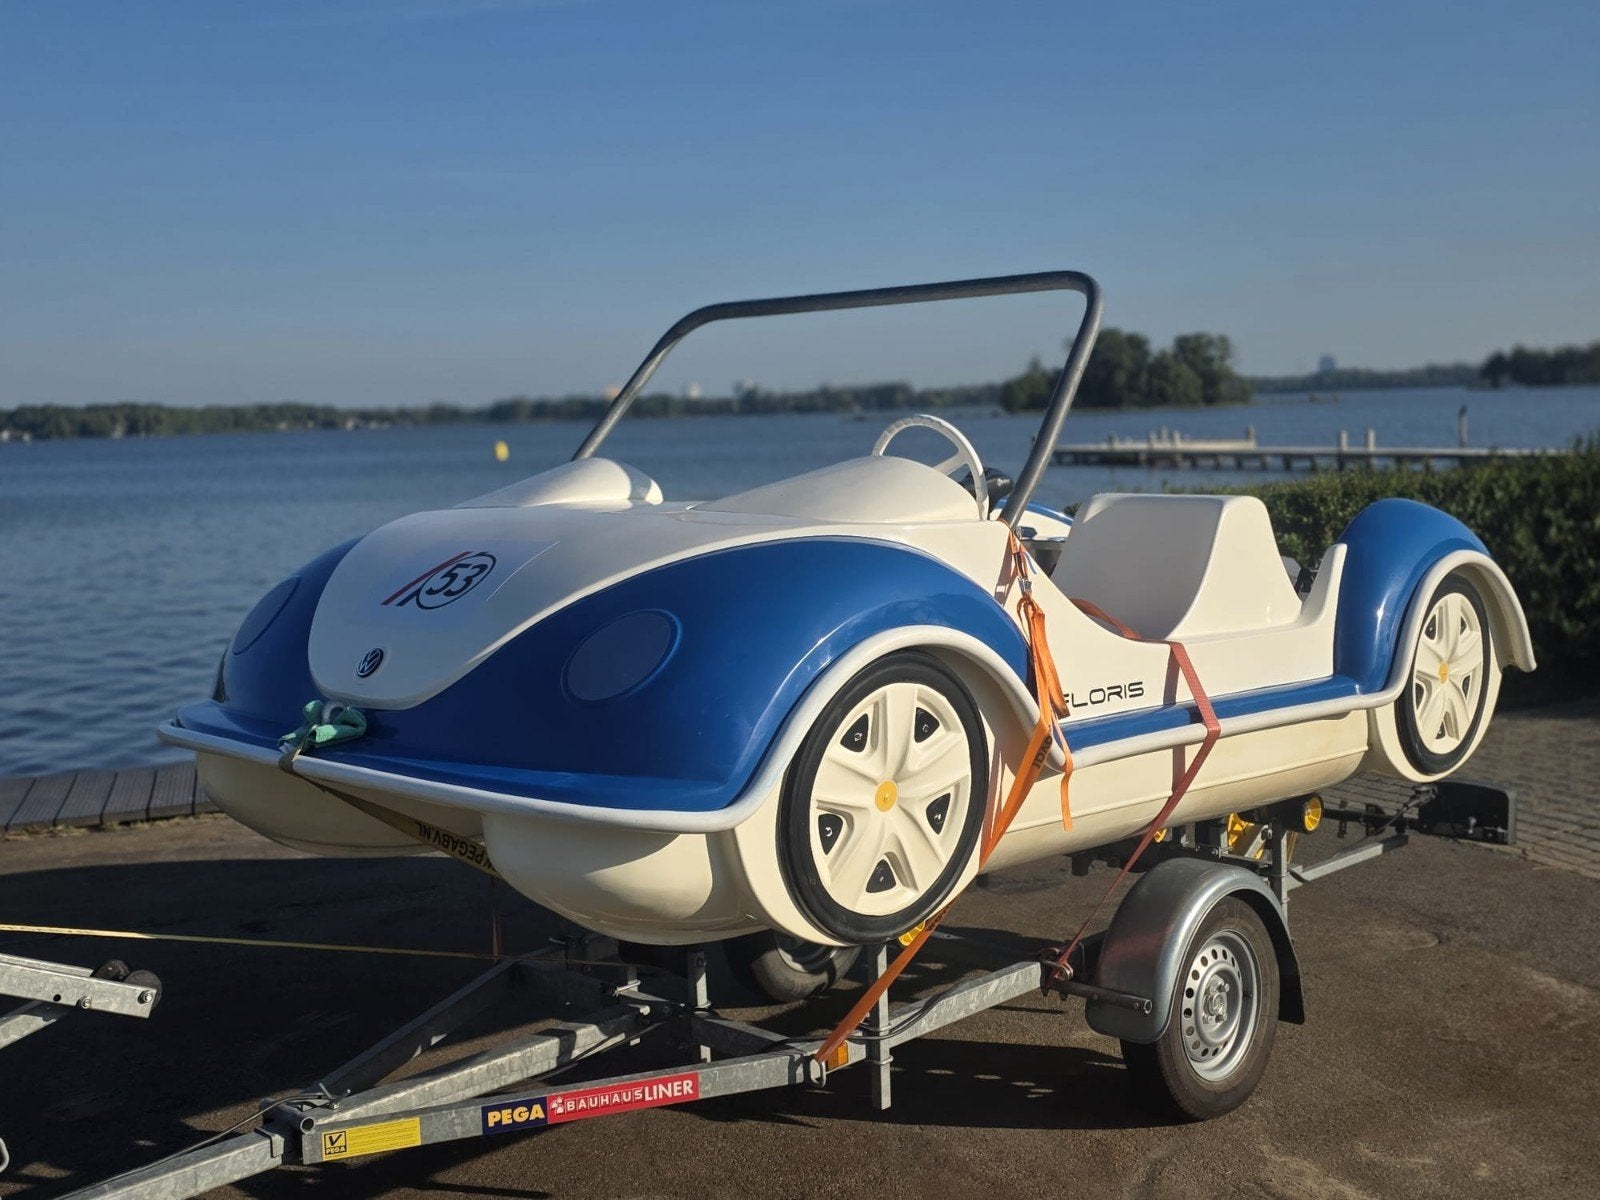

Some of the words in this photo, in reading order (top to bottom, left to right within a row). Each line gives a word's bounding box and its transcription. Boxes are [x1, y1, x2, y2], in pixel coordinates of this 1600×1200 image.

[424, 563, 489, 597] 53
[487, 1103, 546, 1128] PEGA
[325, 1146, 346, 1155] PEGA
